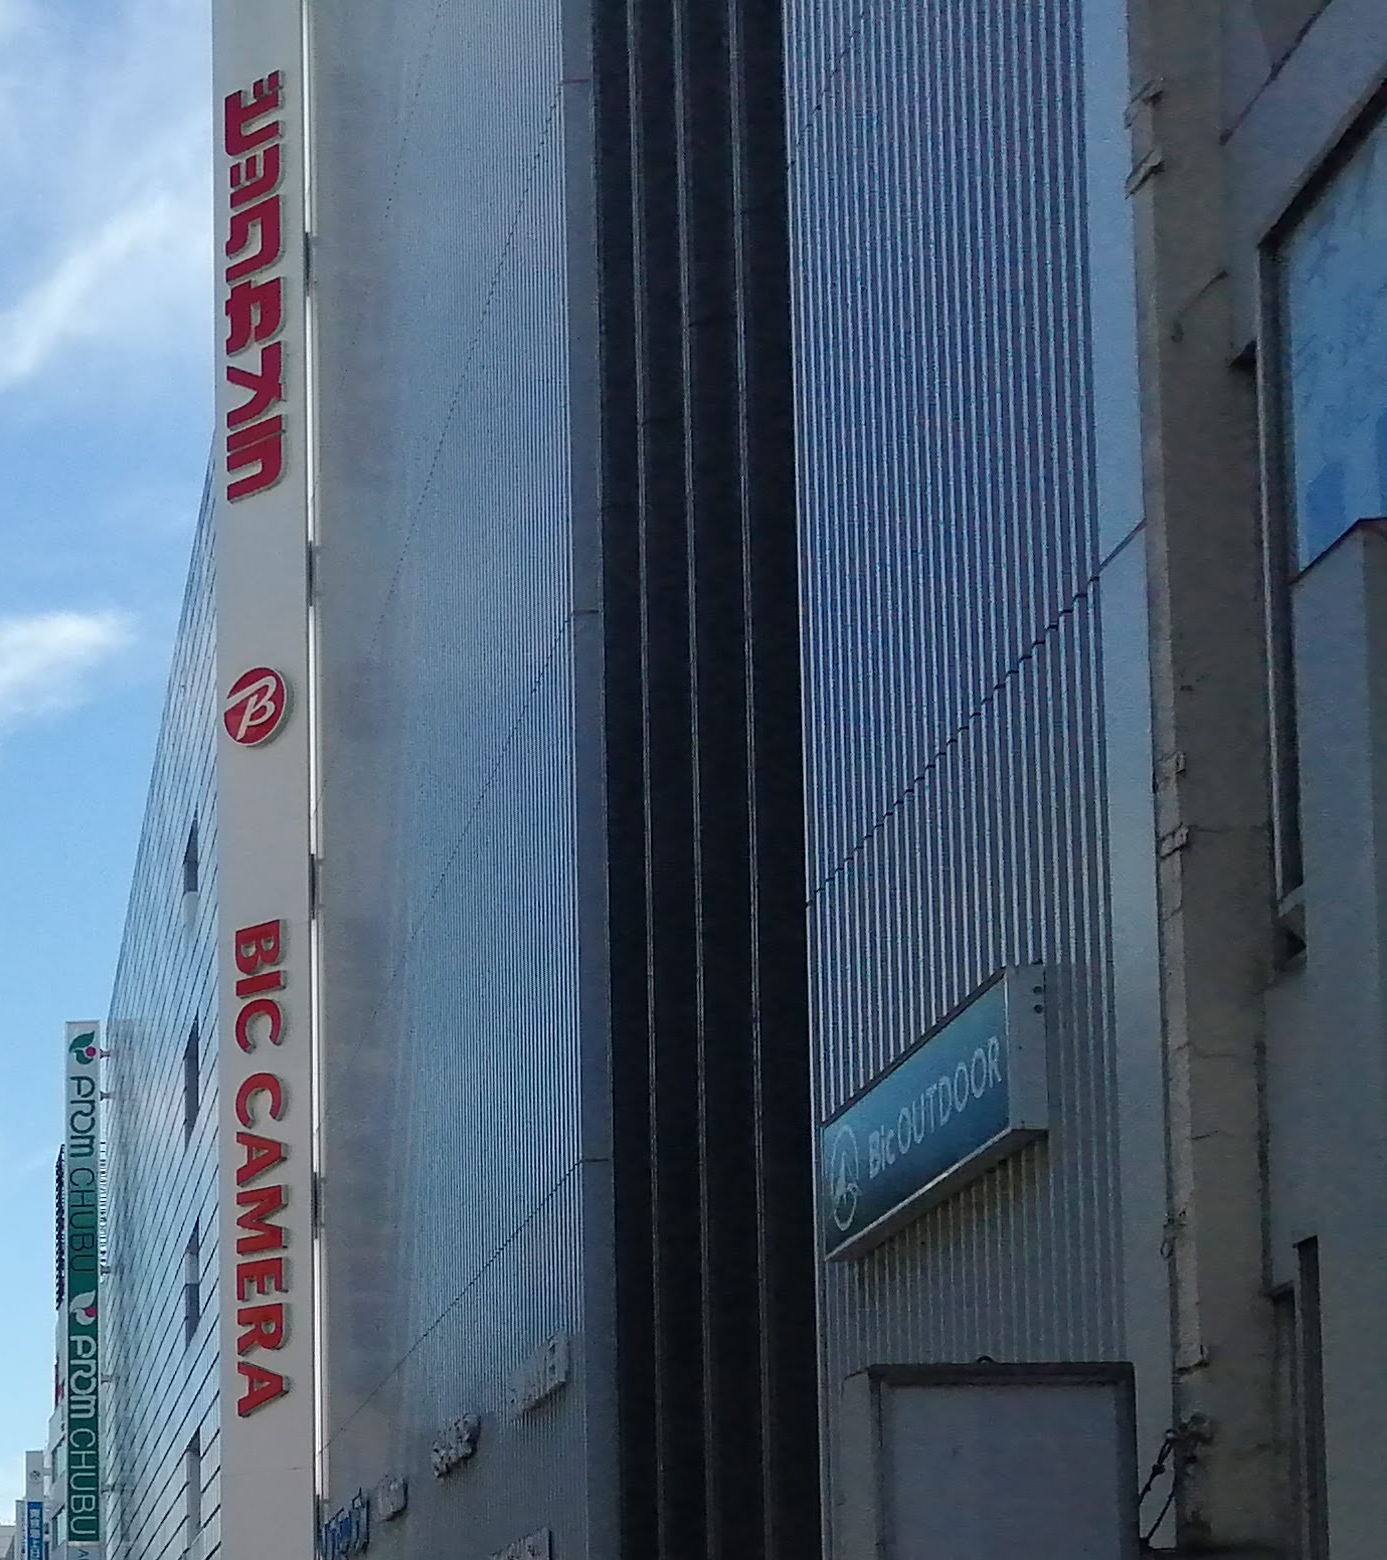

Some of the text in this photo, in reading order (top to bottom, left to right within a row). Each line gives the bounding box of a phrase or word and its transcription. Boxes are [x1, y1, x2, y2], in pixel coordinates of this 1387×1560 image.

[235, 918, 291, 1419] BIC CAMERA
[867, 1035, 1003, 1180] Bic OUTDOOR
[69, 1167, 95, 1274] CHUBU
[69, 1429, 96, 1537] CHUBU
